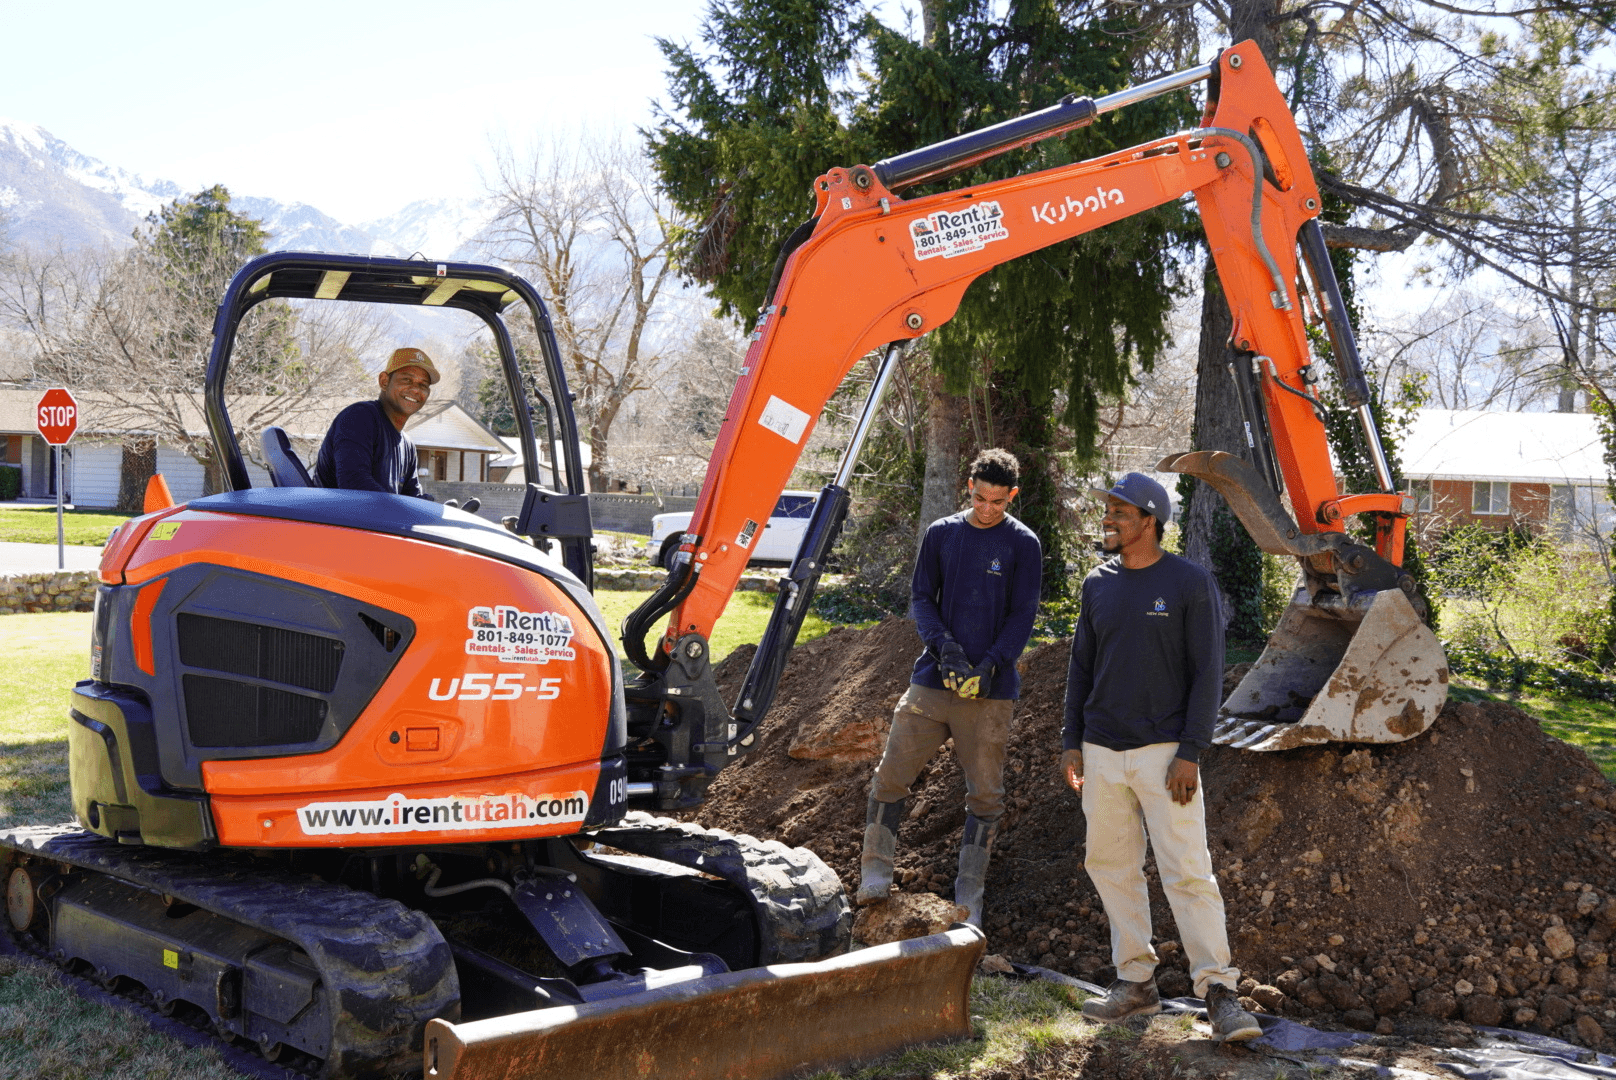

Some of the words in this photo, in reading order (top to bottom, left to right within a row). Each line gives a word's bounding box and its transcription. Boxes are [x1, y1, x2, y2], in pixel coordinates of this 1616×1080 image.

[1031, 186, 1125, 225] Kubota
[931, 208, 981, 232] iRent
[917, 244, 947, 257] Rentals
[953, 238, 974, 248] Sales
[979, 230, 1006, 242] Service
[920, 220, 998, 247] 801-849-1077
[39, 405, 75, 427] STOP
[497, 609, 552, 632] iRent
[469, 642, 506, 653] Rentals
[515, 645, 538, 655] Sales
[544, 647, 573, 658] Service
[477, 629, 568, 647] 801-849-1077
[428, 673, 562, 701] U55-5
[304, 796, 585, 827] www.irentutah.com
